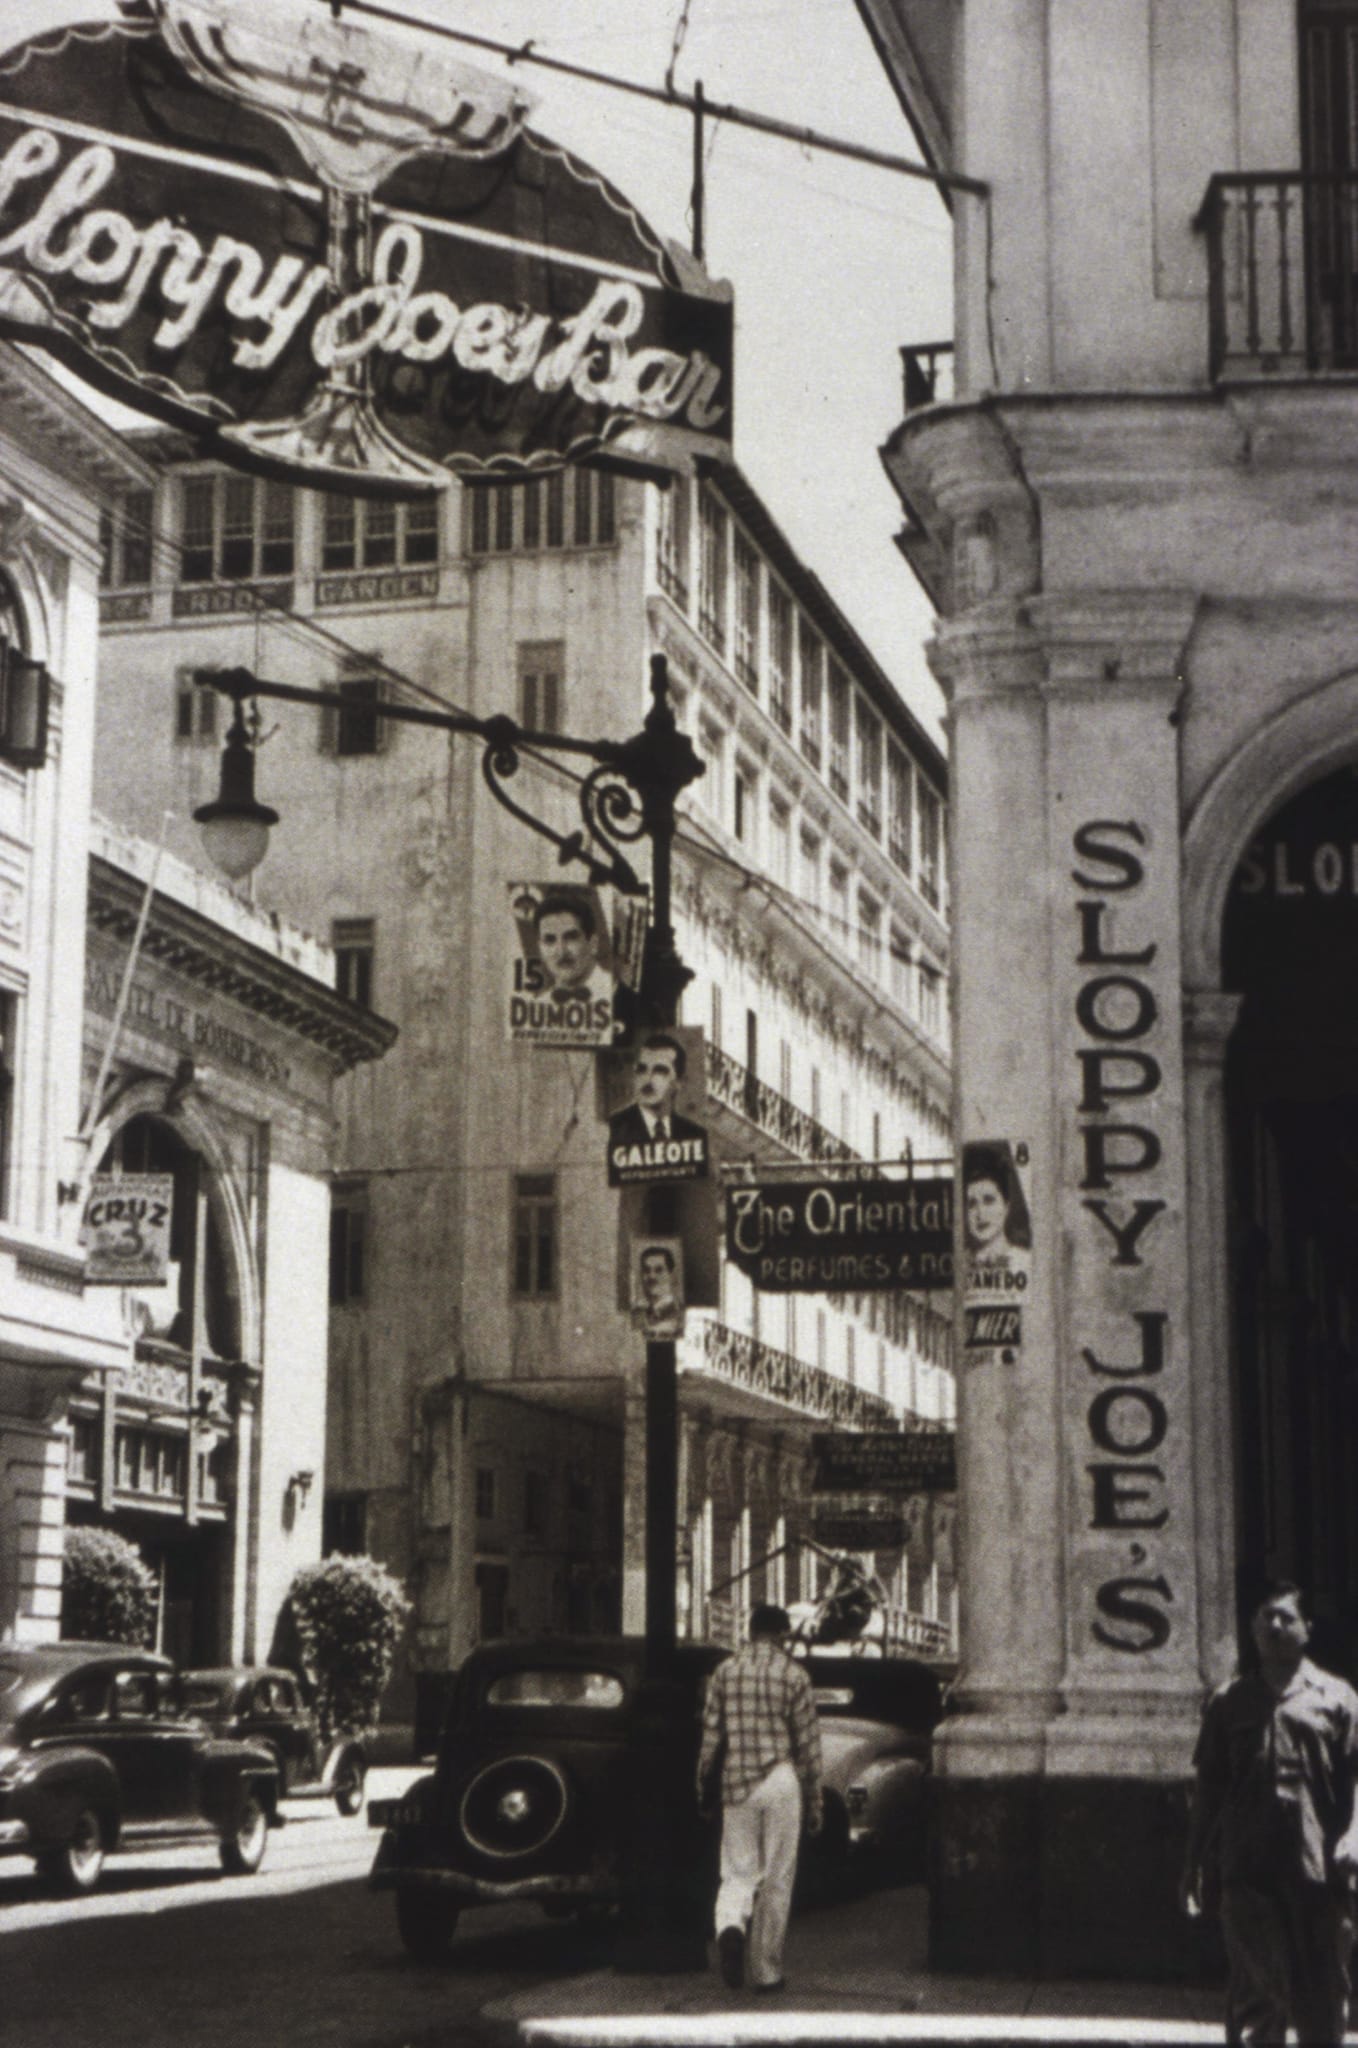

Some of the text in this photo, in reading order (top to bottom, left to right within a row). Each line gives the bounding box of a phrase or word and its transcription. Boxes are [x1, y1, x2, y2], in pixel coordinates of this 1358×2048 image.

[533, 281, 728, 429] Bar
[1238, 841, 1358, 896] SLO
[513, 957, 545, 993] 15
[510, 996, 611, 1031] DUMOIS
[612, 1138, 705, 1169] GALEOTE
[89, 1198, 169, 1228] CRUZ
[731, 1188, 952, 1254] The Oriental
[1071, 819, 1174, 1654] SLOPPY JOE'S
[760, 1253, 891, 1282] PERFUMES
